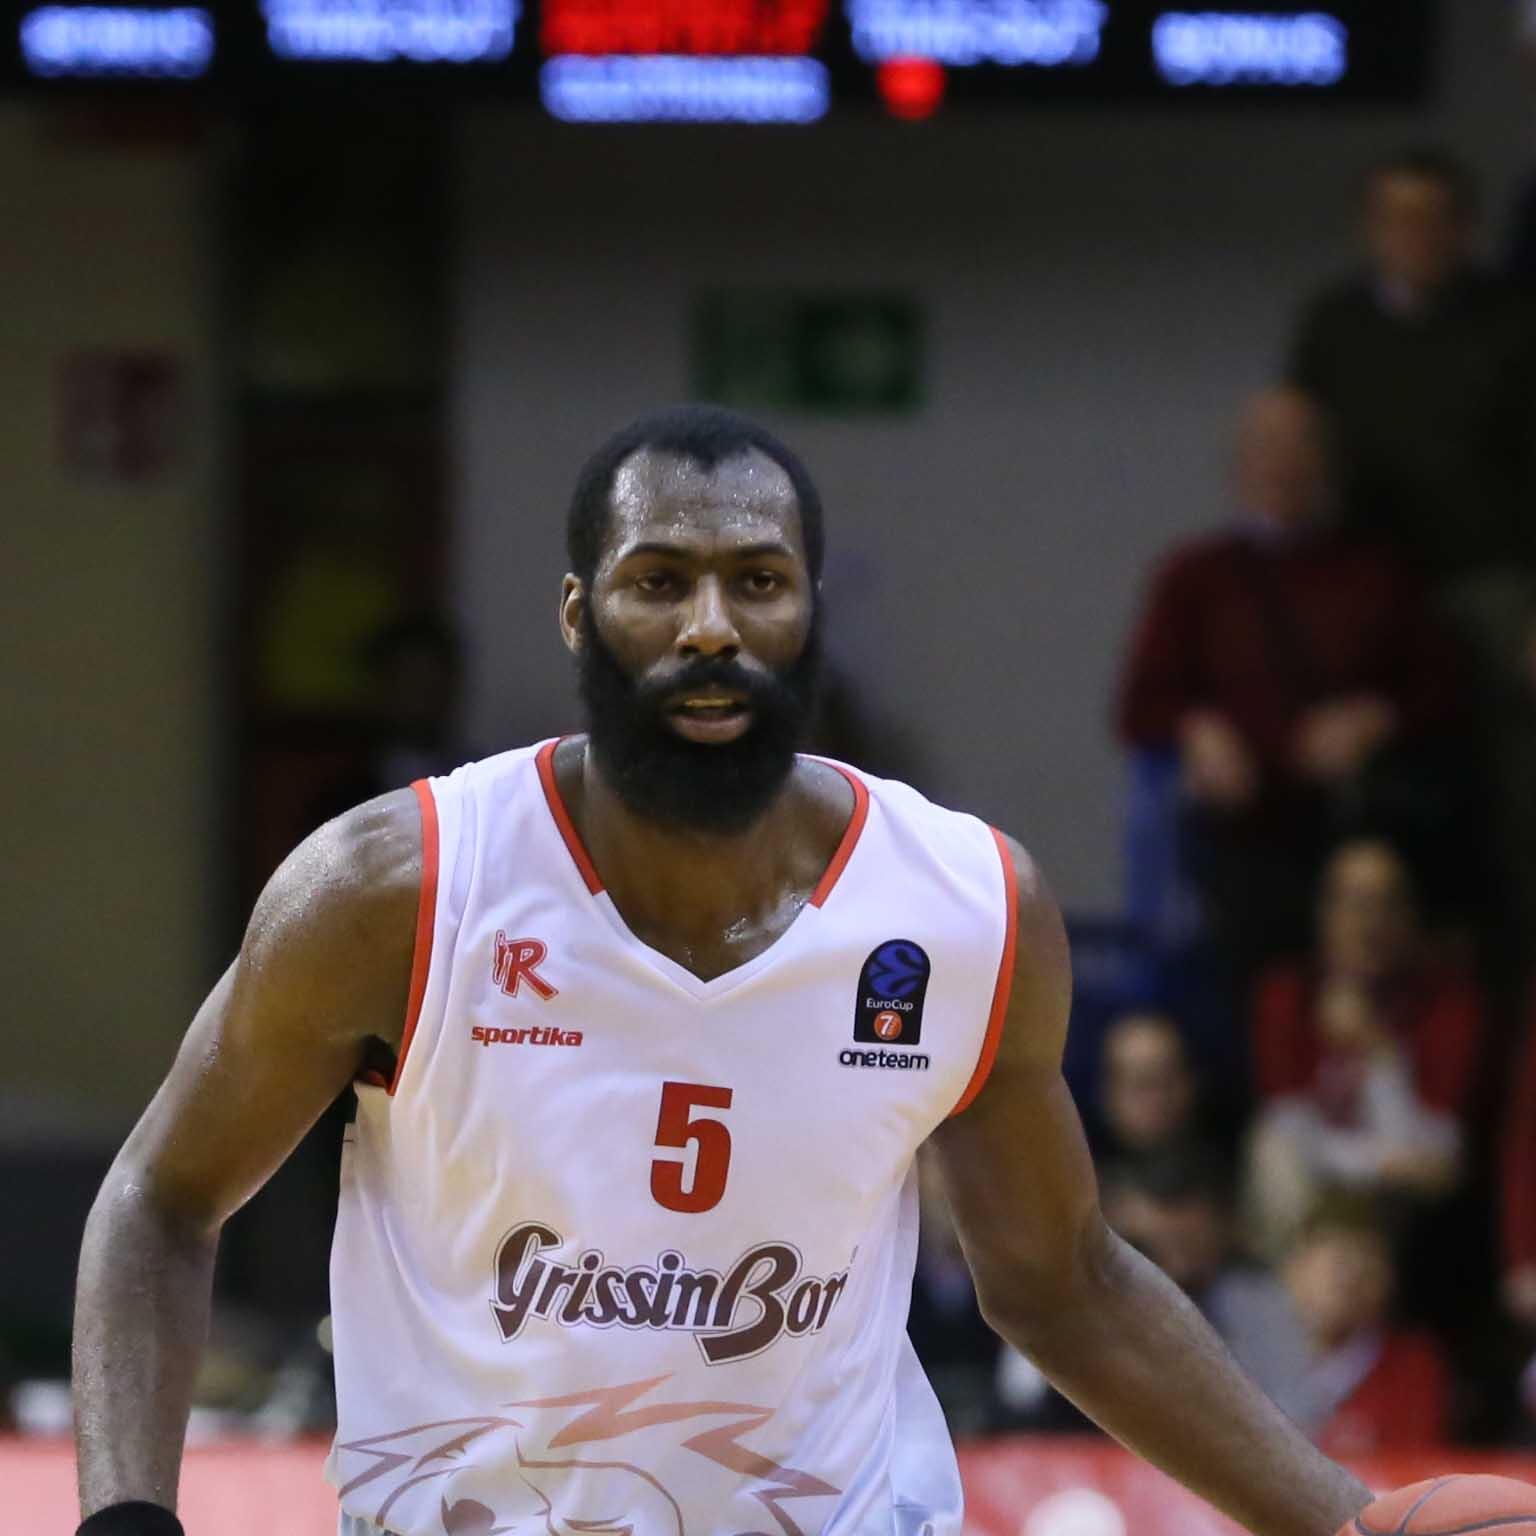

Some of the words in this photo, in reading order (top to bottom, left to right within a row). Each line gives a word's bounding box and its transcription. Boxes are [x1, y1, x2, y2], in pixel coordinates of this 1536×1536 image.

[866, 997, 914, 1012] EuroCup
[472, 1026, 583, 1048] sportika
[838, 1048, 930, 1071] oneteam
[649, 1080, 733, 1214] 5
